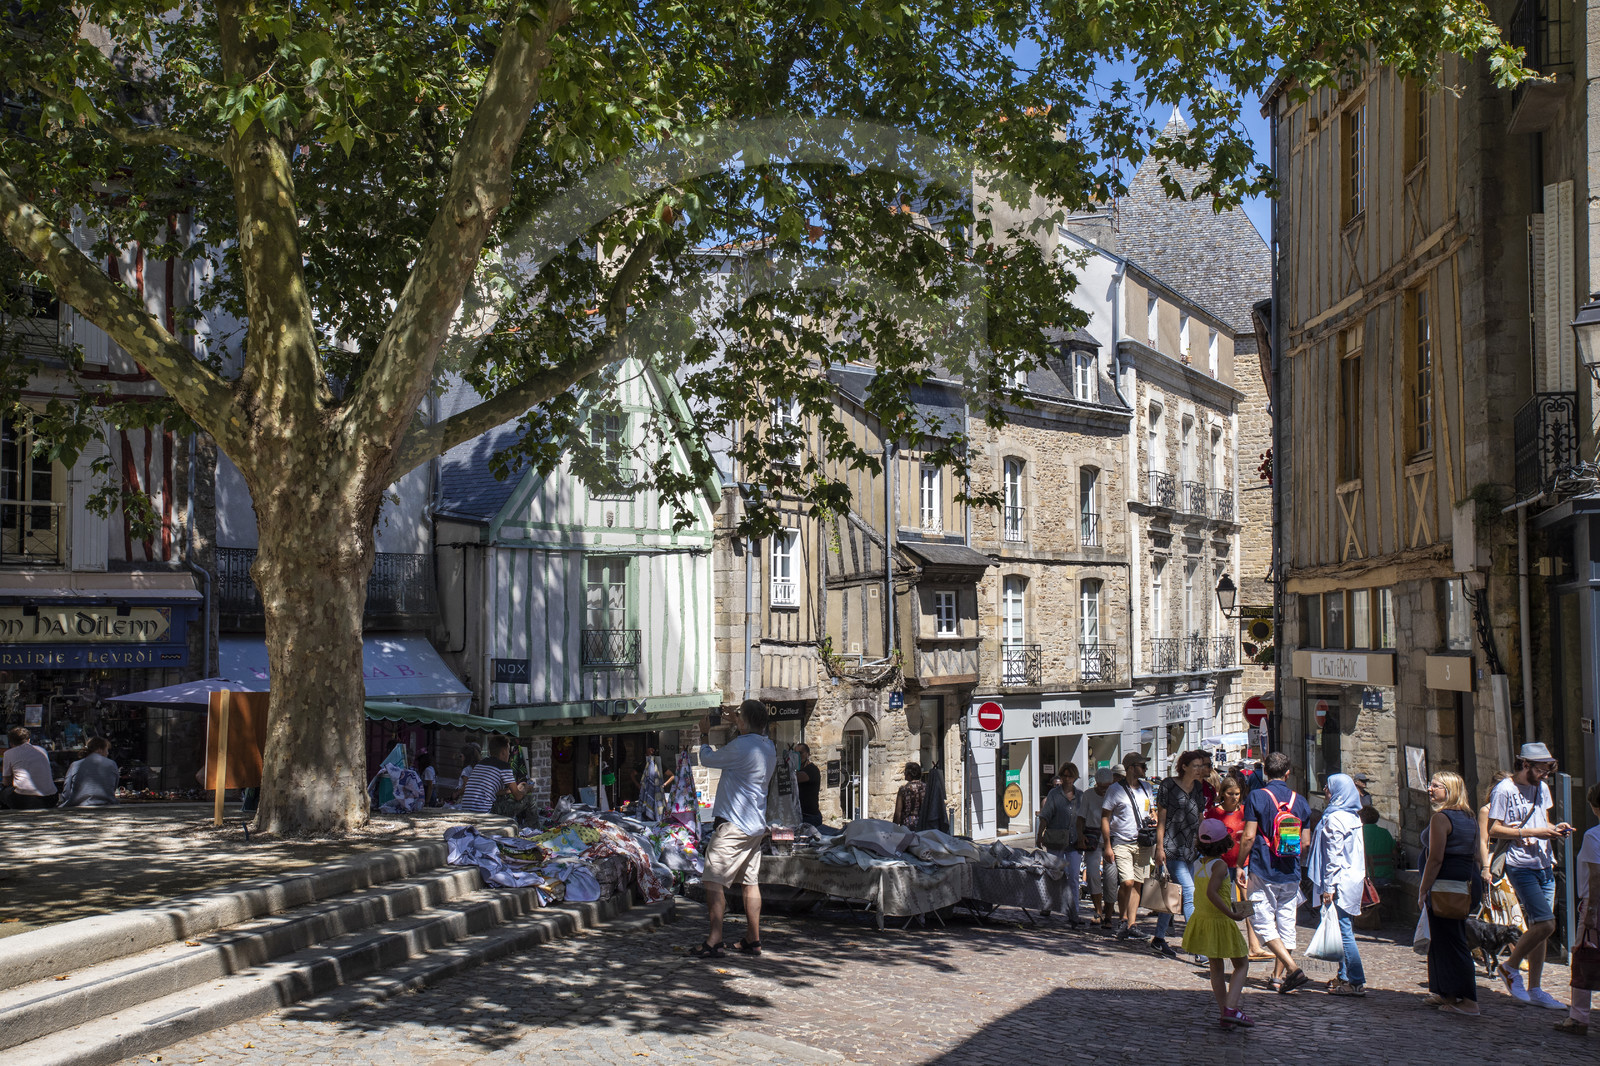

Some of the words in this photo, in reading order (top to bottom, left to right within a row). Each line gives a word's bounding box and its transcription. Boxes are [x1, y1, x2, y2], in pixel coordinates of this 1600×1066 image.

[497, 664, 526, 674] NOX
[1445, 664, 1450, 680] 3
[591, 697, 648, 717] NOX
[1032, 709, 1092, 729] SPRINGFIELD
